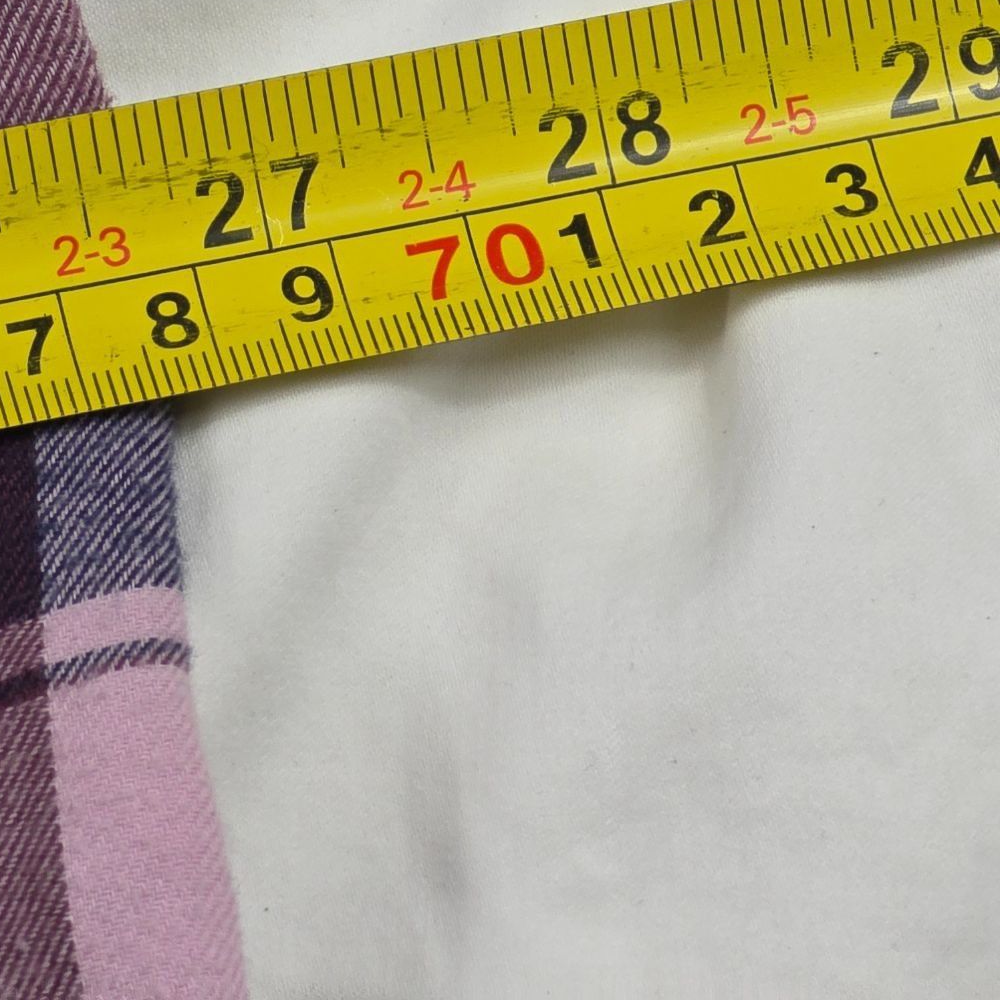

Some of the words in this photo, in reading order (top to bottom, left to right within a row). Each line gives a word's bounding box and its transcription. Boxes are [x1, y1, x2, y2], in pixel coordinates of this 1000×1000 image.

[6, 315, 55, 376] 7
[145, 291, 200, 350] 8
[280, 265, 335, 323] 9
[405, 222, 545, 301] 70
[558, 213, 602, 269] 1
[688, 189, 747, 248] 2
[823, 162, 880, 218] 3
[52, 227, 131, 277] 2-3
[195, 153, 320, 249] 27
[398, 159, 477, 211] 2-4
[537, 88, 672, 185] 28
[739, 94, 818, 145] 2-5
